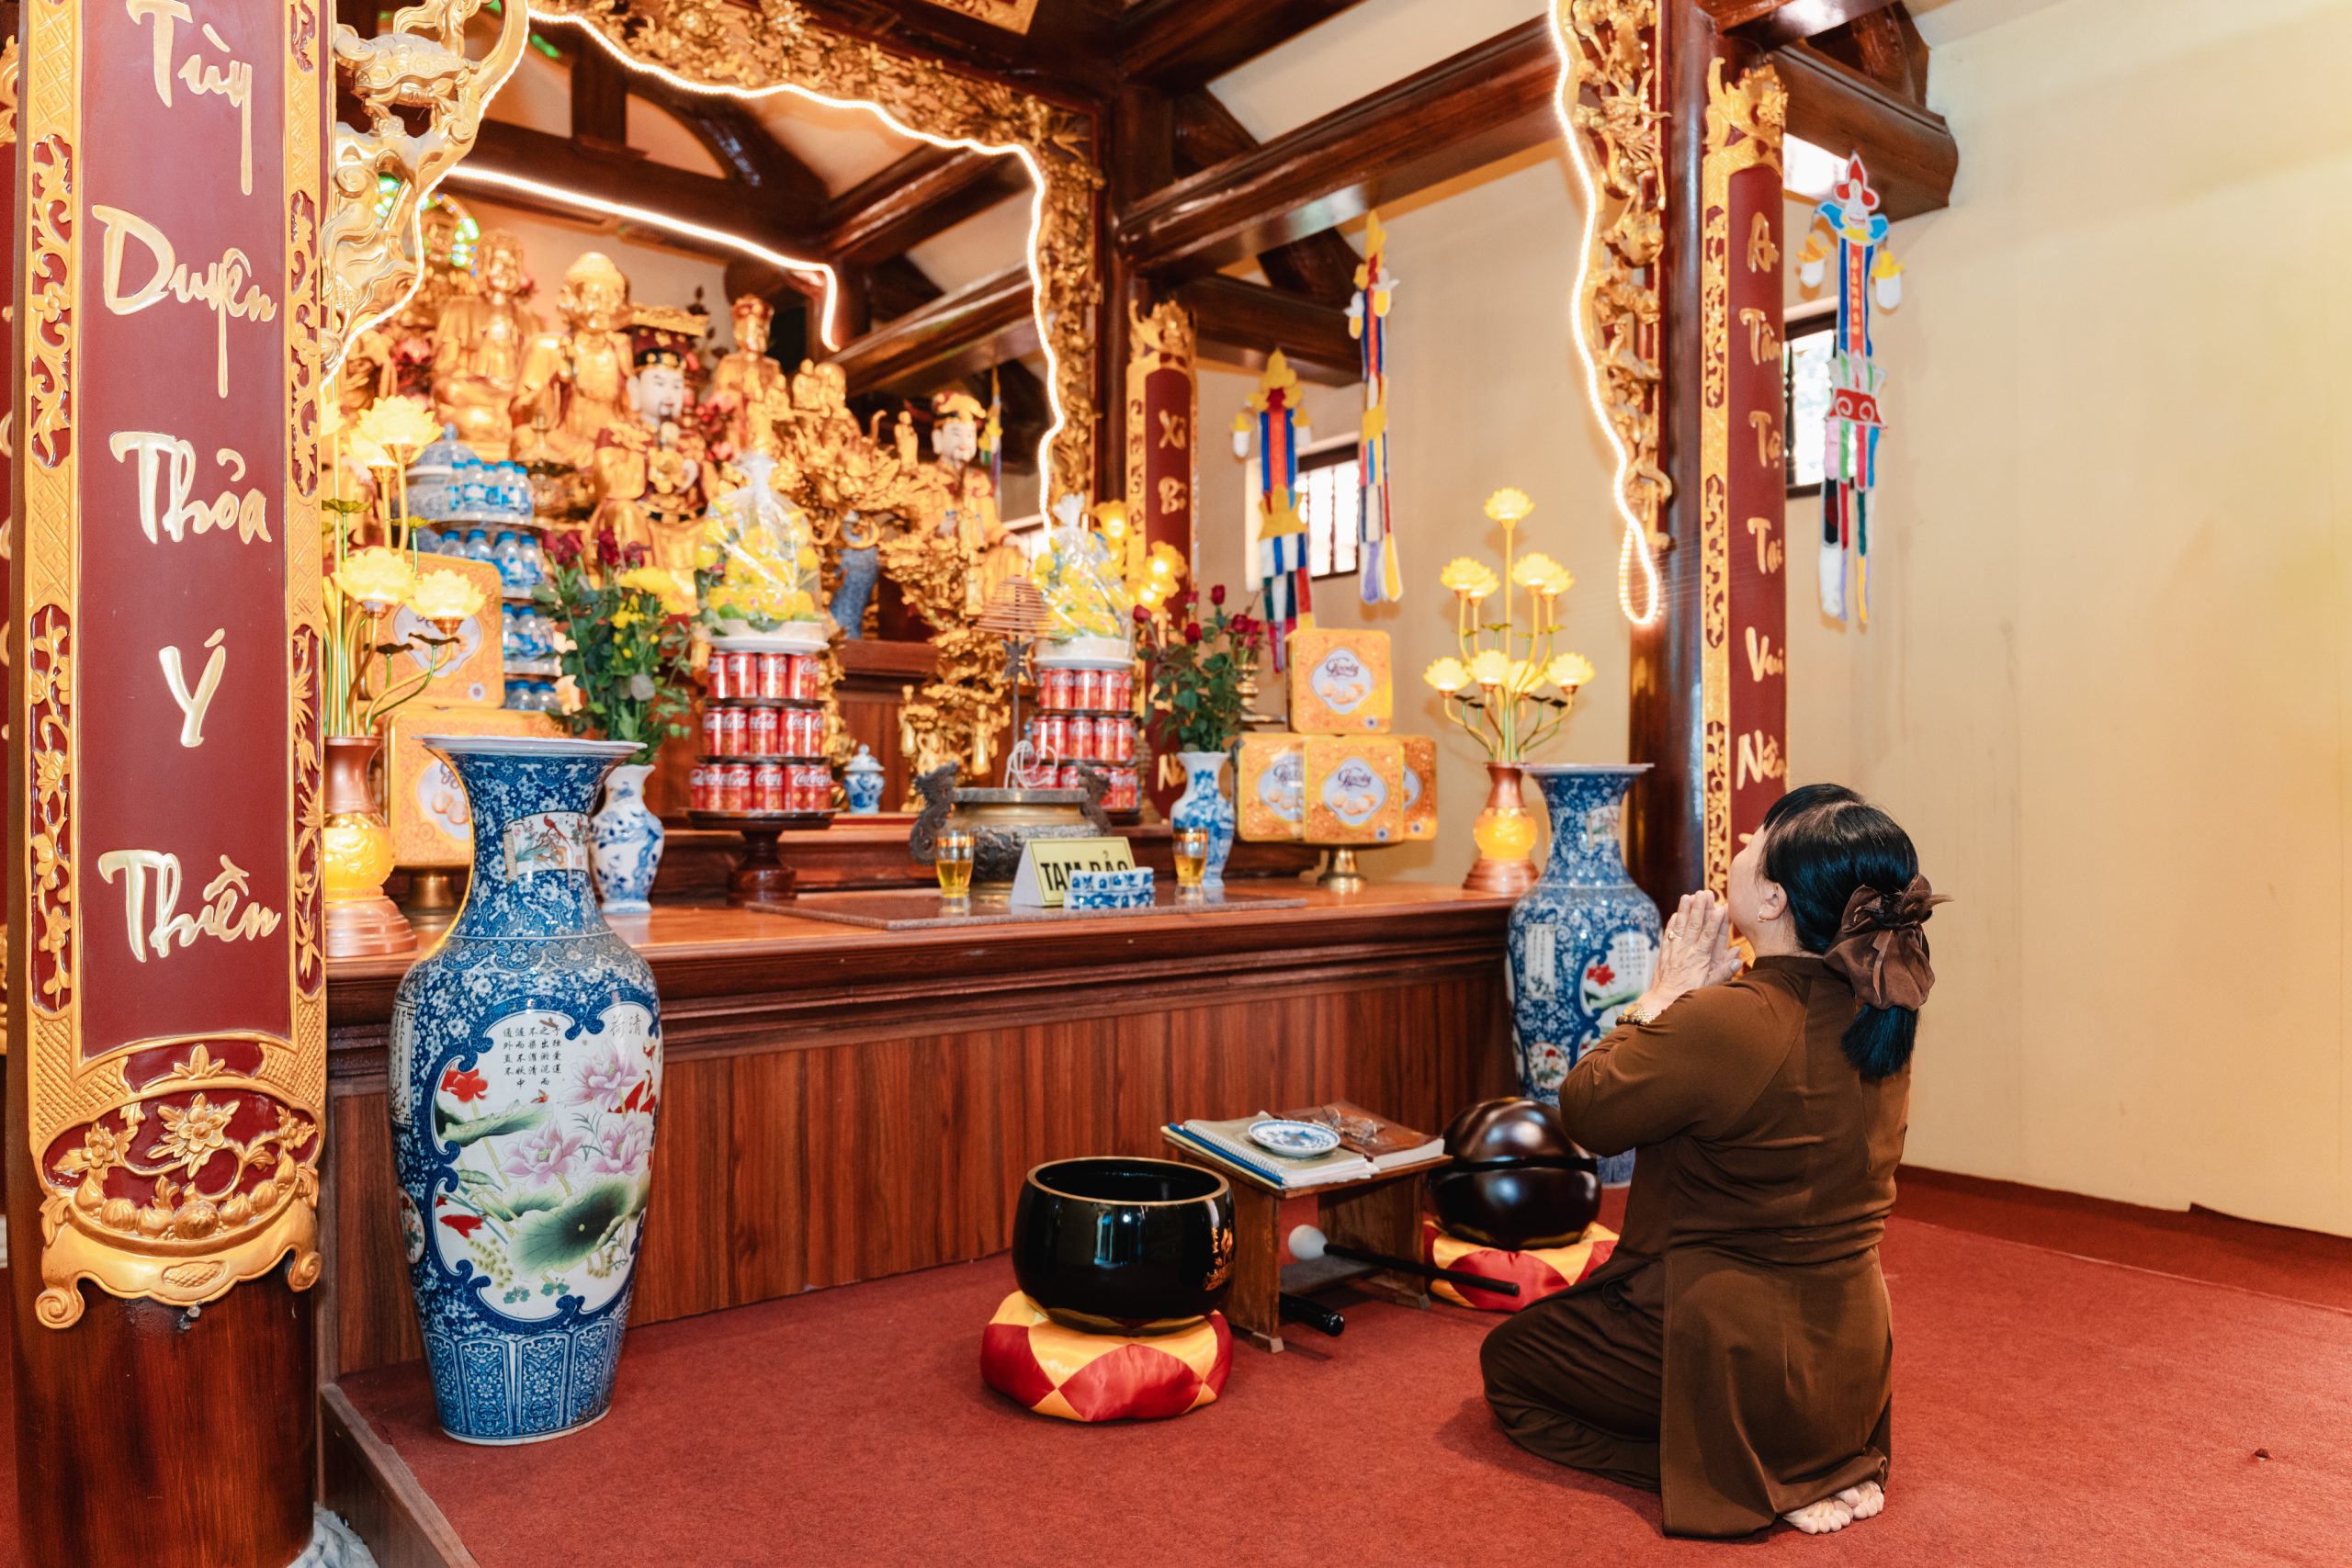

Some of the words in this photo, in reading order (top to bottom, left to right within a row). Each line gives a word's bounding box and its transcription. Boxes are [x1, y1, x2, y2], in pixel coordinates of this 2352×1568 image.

[92, 204, 277, 398] Duyên
[109, 431, 273, 544] Thỏa
[158, 627, 226, 748] Ý
[97, 850, 282, 963] Thiền
